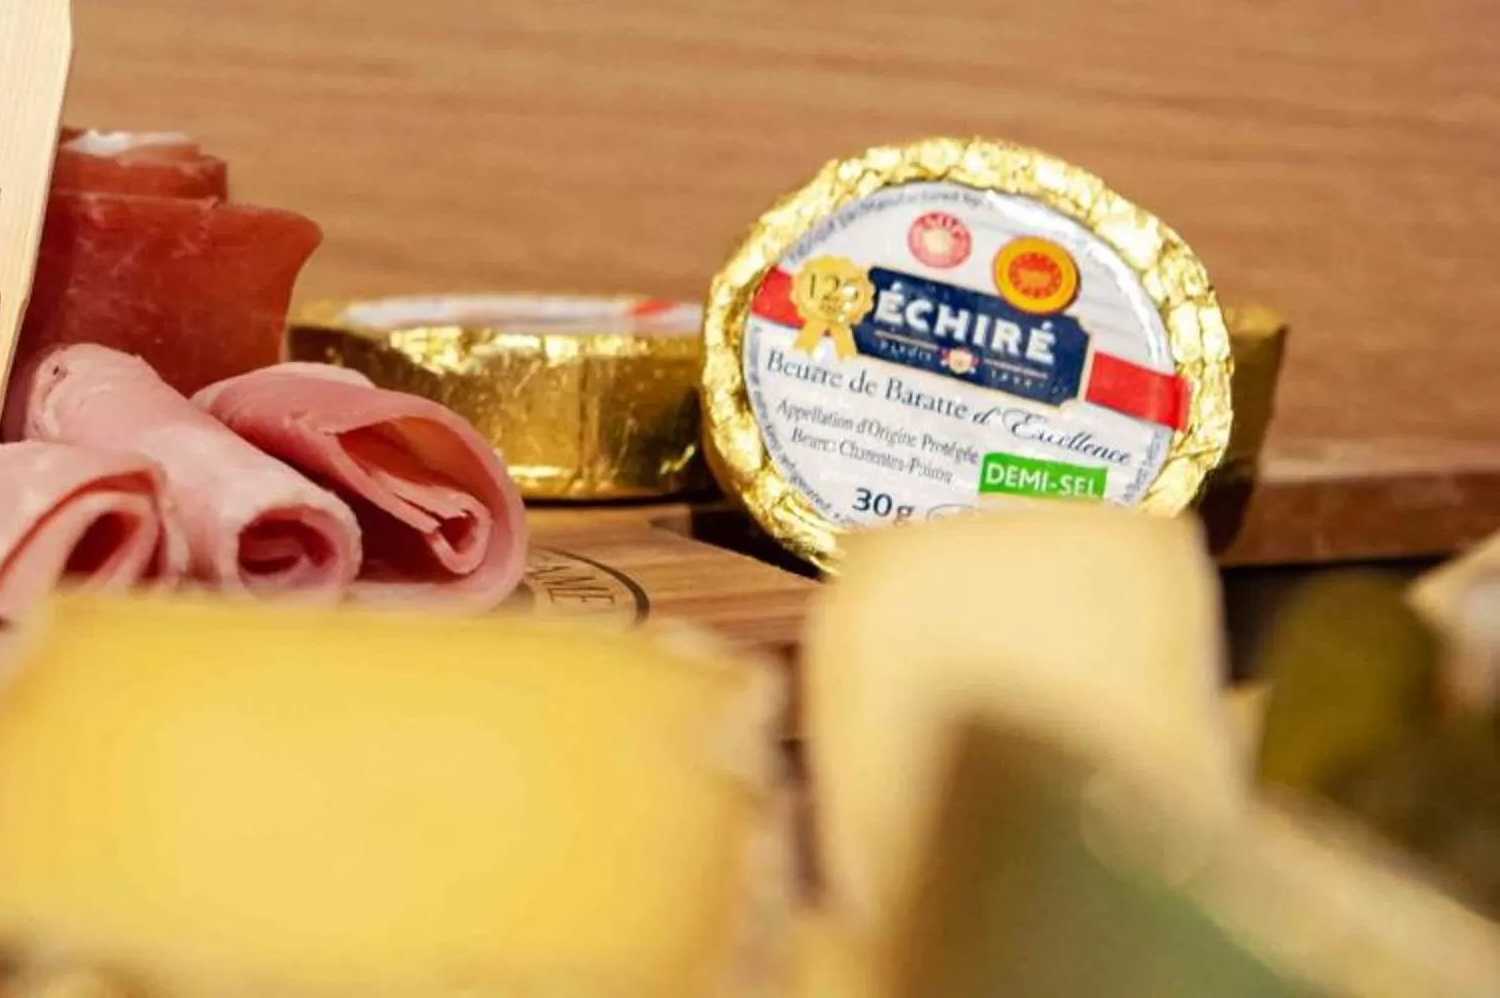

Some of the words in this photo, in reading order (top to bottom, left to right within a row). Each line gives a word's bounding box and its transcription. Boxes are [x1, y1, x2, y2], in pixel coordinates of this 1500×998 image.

[873, 281, 1058, 366] ÉCHIRÉ
[766, 349, 845, 389] Beurre
[848, 368, 878, 396] de
[884, 376, 969, 419] Baratte
[775, 398, 855, 431] Appellation
[984, 461, 1098, 499] DEMI-SEL
